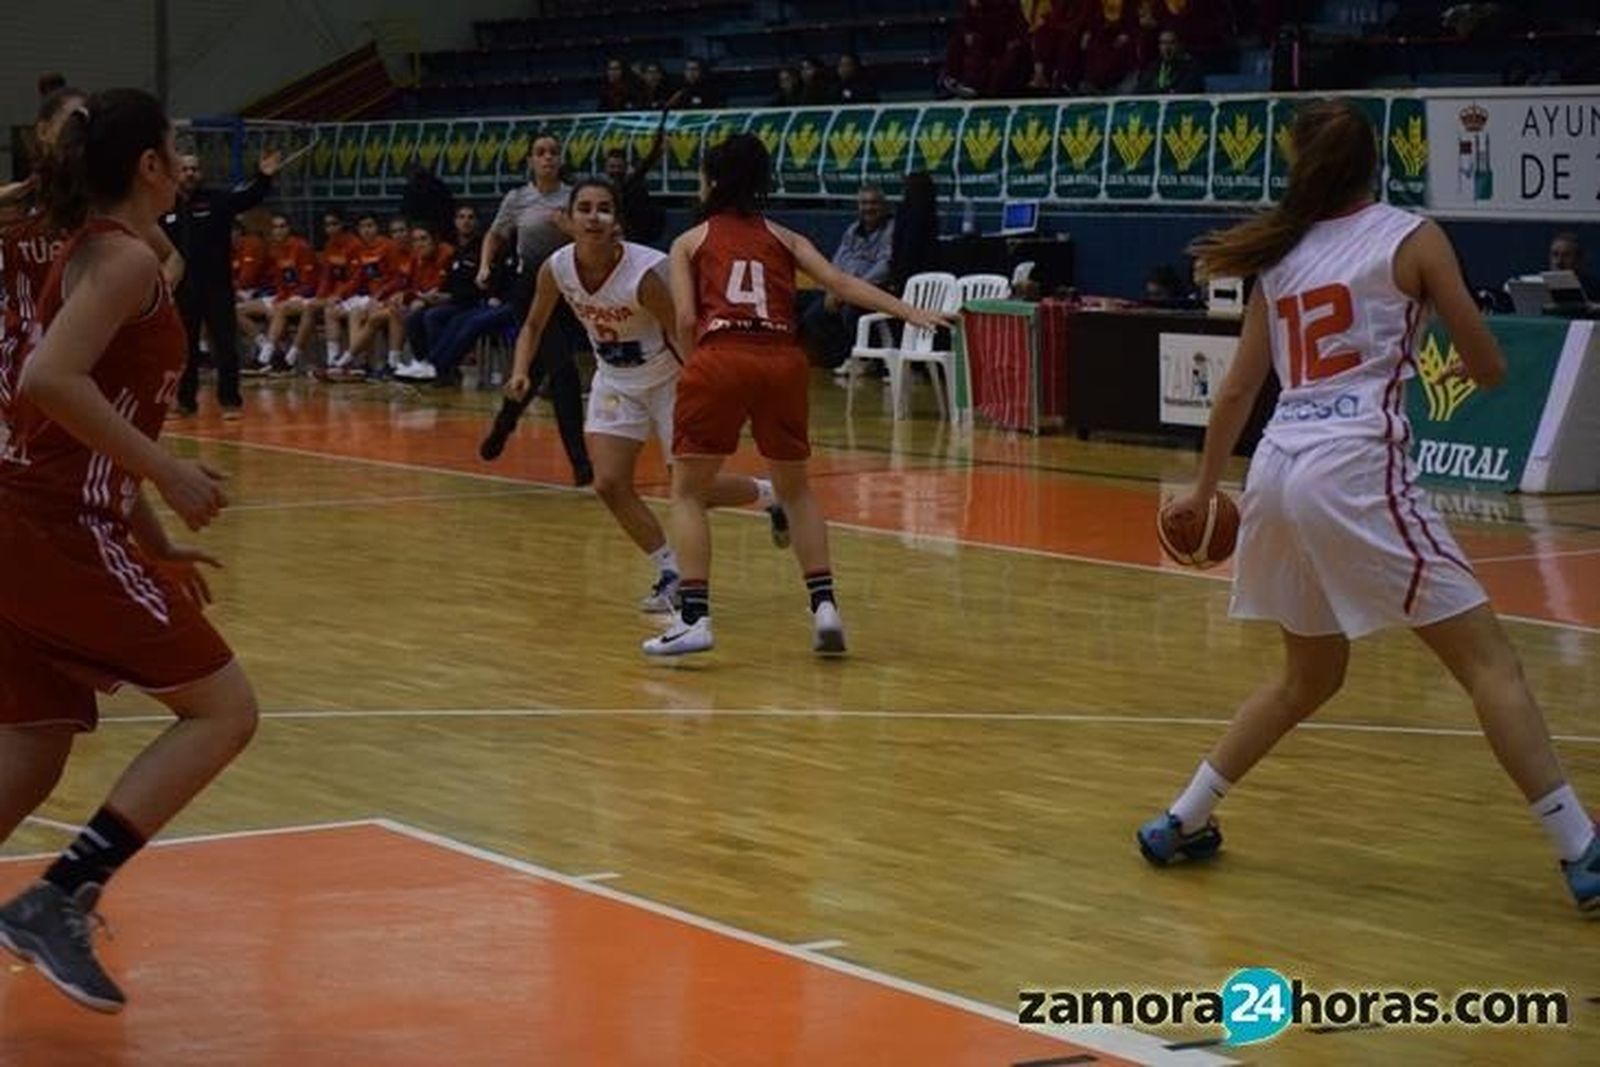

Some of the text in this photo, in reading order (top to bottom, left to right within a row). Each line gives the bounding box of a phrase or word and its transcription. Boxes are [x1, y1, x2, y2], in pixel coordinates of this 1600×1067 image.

[1521, 153, 1571, 200] DE
[726, 260, 768, 319] 4
[1276, 282, 1362, 389] 12
[1417, 440, 1510, 481] RURAL
